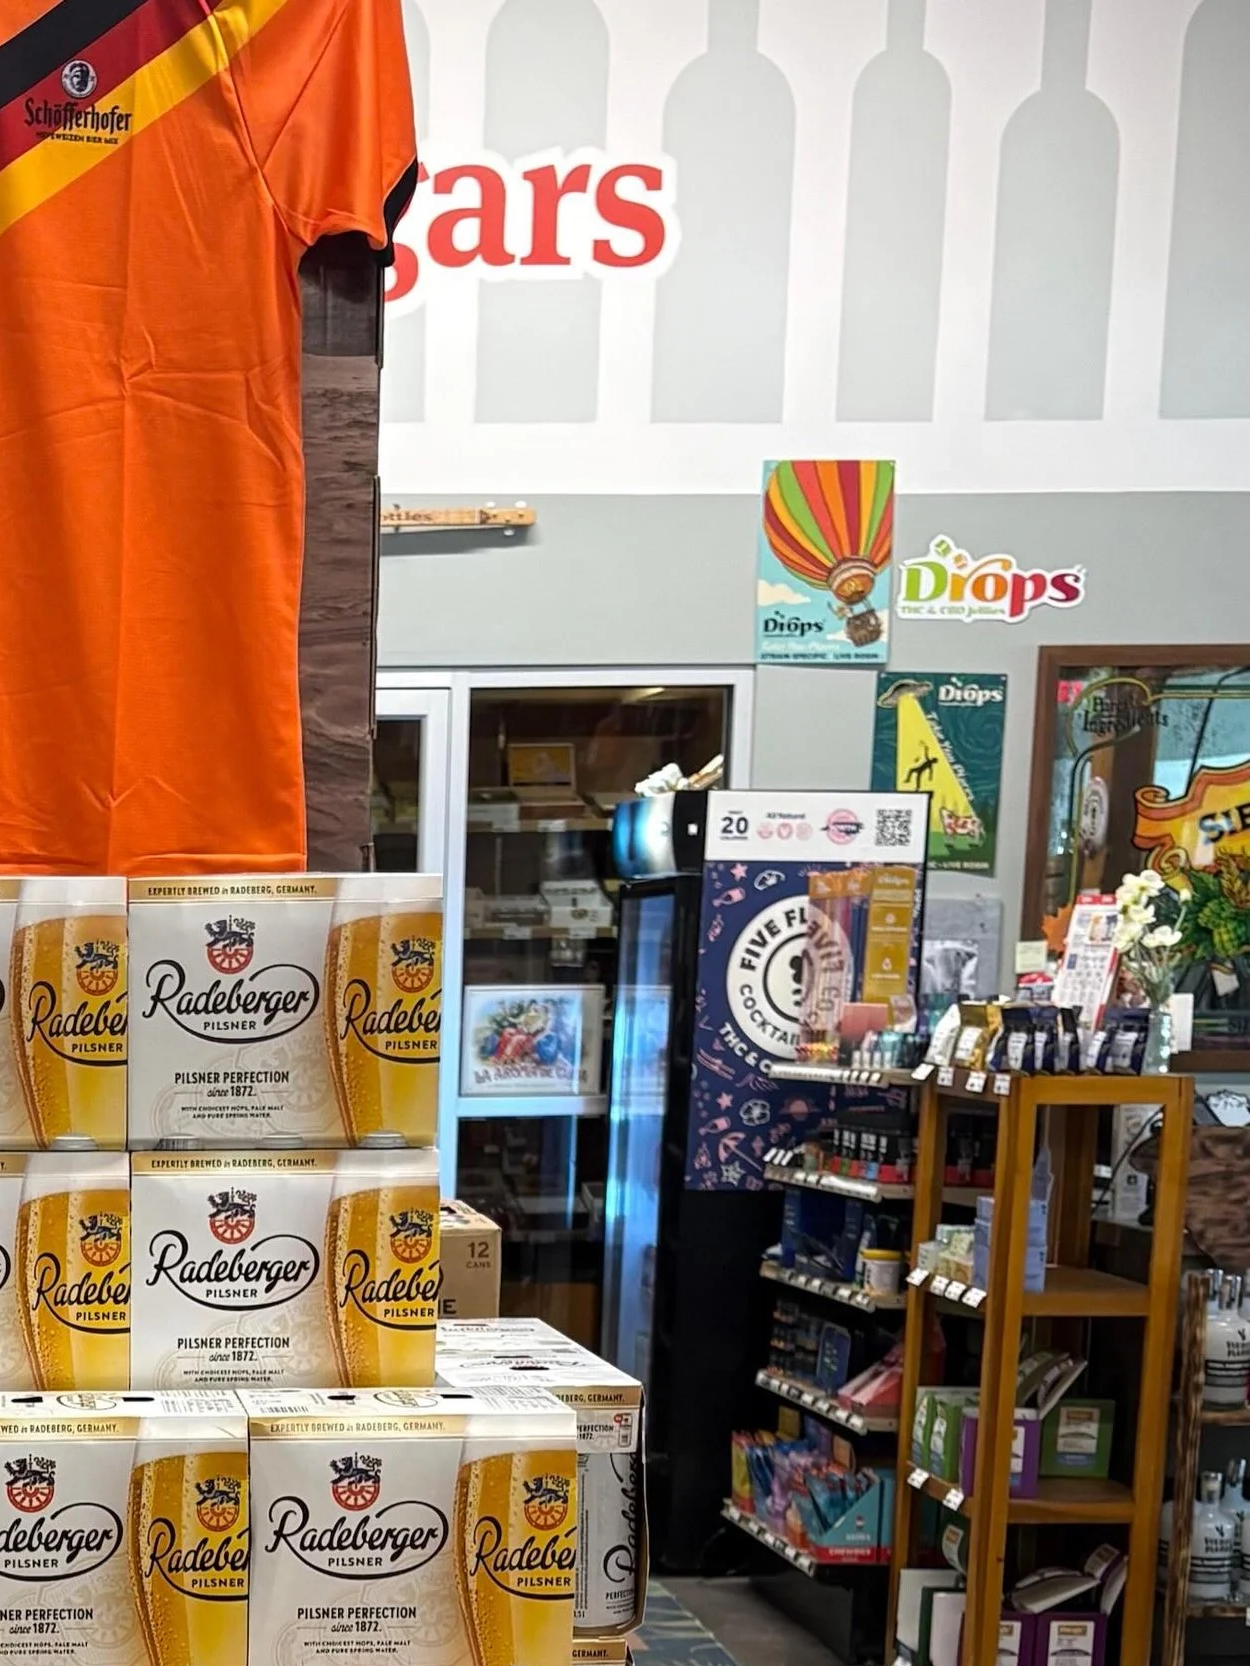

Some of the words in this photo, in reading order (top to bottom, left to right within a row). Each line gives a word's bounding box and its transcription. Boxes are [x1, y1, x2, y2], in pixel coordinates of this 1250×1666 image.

[24, 98, 132, 134] Schöfferhofer
[902, 559, 1081, 618] Drops
[763, 616, 825, 637] Drops
[938, 684, 1003, 706] Drops
[721, 816, 749, 836] 20
[740, 919, 781, 972] FIVE
[142, 959, 310, 1025] Radeberger
[719, 1022, 748, 1057] THC
[146, 1230, 310, 1292] Radeberger
[467, 1241, 489, 1258] 12
[206, 1289, 258, 1298] PILSNER
[265, 1496, 439, 1562] Radeberger
